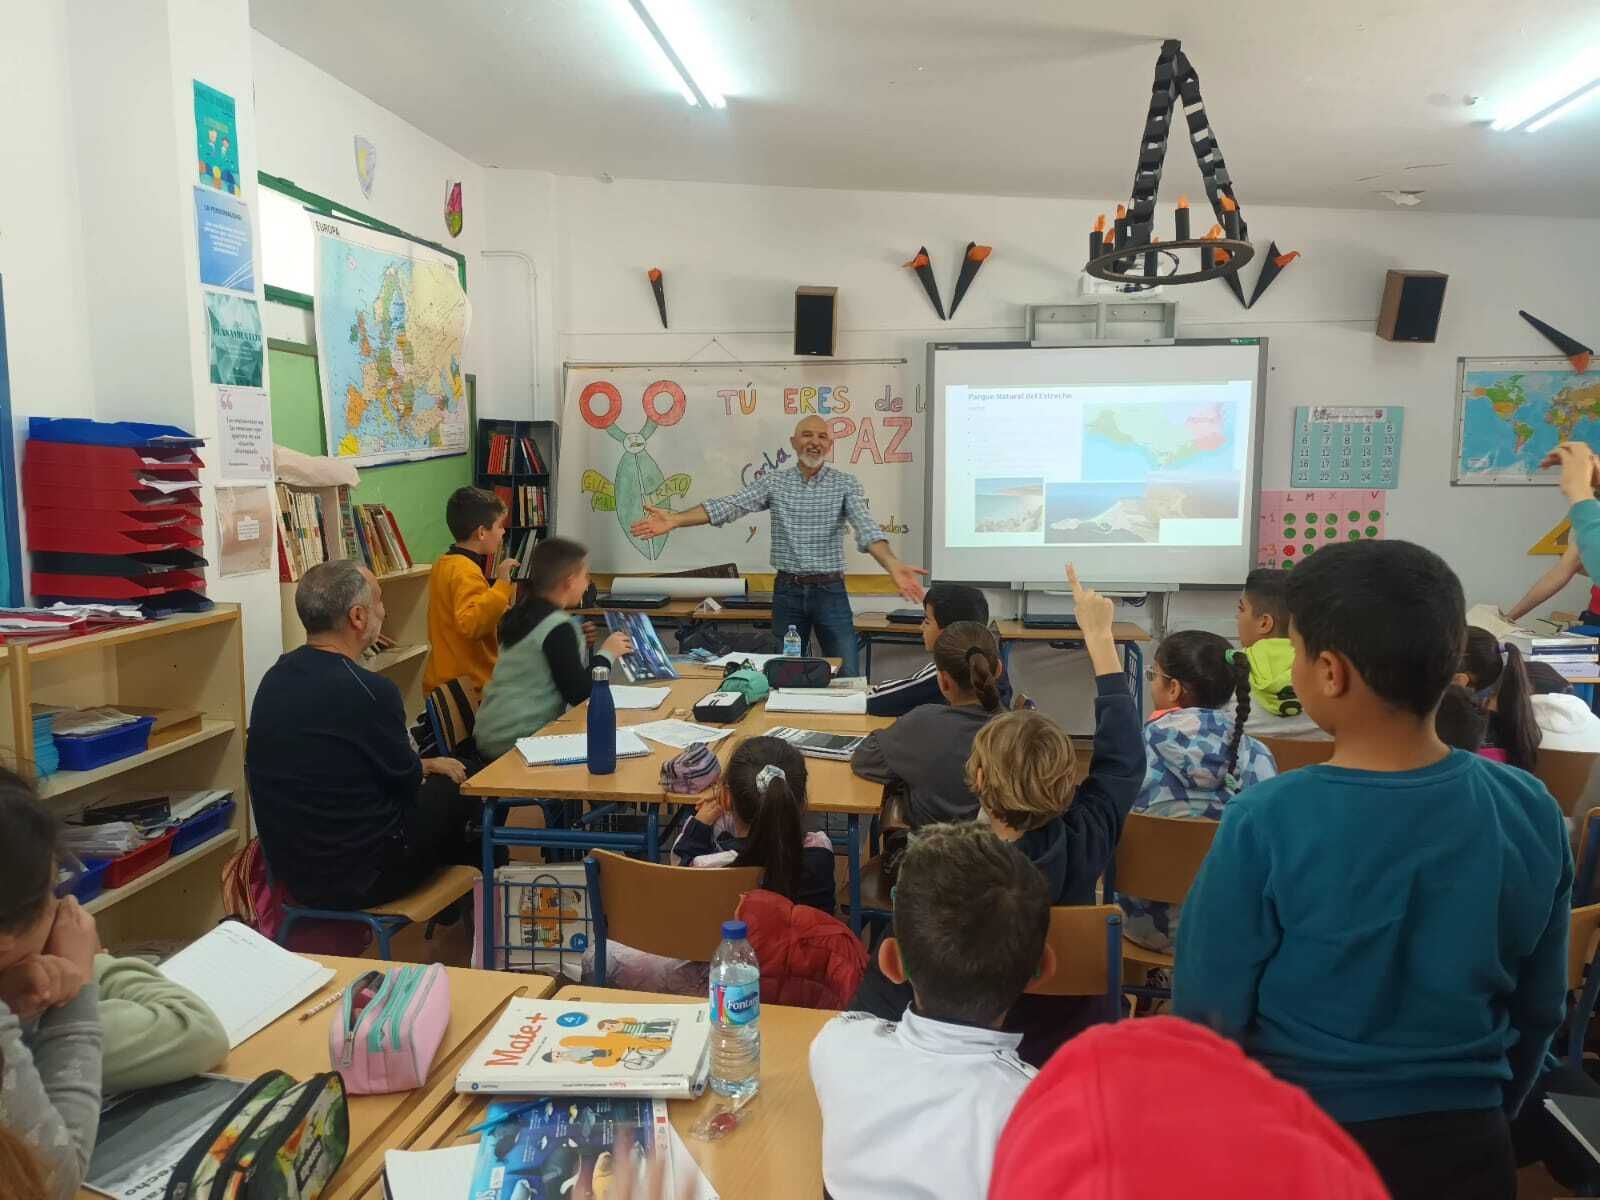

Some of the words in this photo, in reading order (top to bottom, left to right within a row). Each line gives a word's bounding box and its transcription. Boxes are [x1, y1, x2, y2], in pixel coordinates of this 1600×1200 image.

[315, 219, 340, 235] EUROPA
[717, 382, 757, 416] TÚ
[783, 385, 851, 415] ERES
[874, 384, 904, 412] de
[825, 416, 914, 465] PAZ
[1286, 493, 1293, 502] L
[1305, 493, 1315, 501] M
[1371, 490, 1380, 499] V
